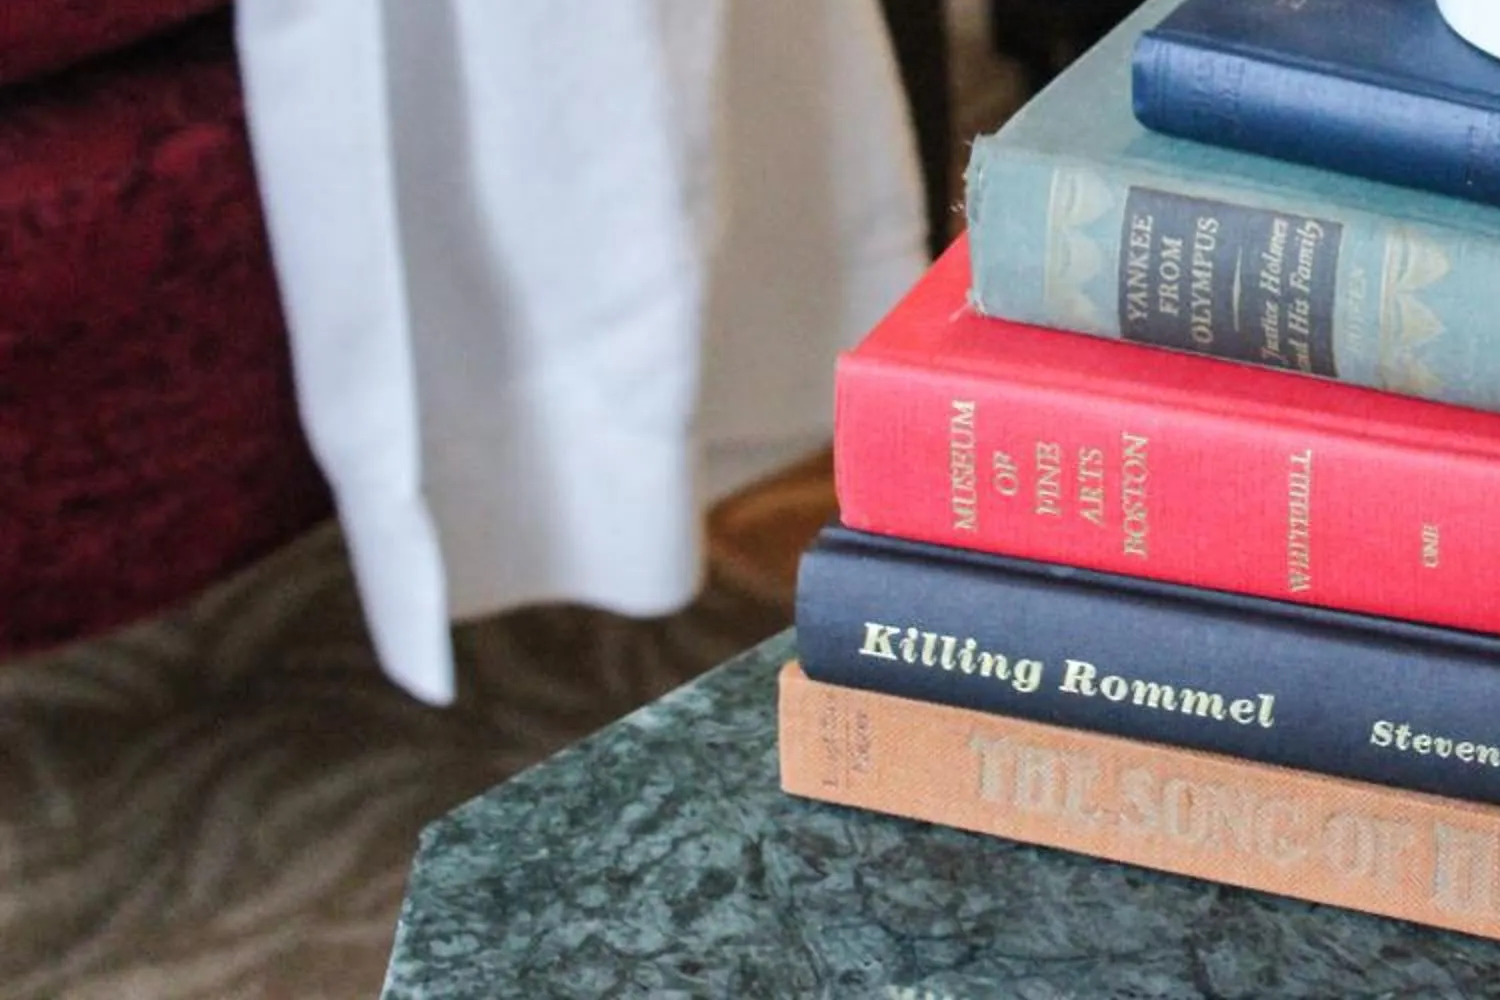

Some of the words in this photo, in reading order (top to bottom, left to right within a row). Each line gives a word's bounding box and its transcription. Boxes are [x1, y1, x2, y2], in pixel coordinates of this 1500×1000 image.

[1127, 213, 1154, 324] YANKEE
[1159, 235, 1183, 318] FROM
[1192, 216, 1220, 346] OLYMPUS
[1259, 218, 1289, 293] Holmes
[1289, 219, 1326, 293] Family
[1260, 294, 1288, 362] Justice
[1286, 297, 1310, 337] His
[950, 399, 977, 533] MUSEUM
[993, 451, 1021, 499] OF
[1035, 441, 1060, 516] FINE
[1079, 446, 1104, 528] ARTS
[1123, 432, 1149, 559] BOSTON
[858, 621, 1043, 694] Killing
[1058, 658, 1276, 729] Rommel
[968, 728, 1102, 822] THE
[1117, 763, 1308, 867] SONG
